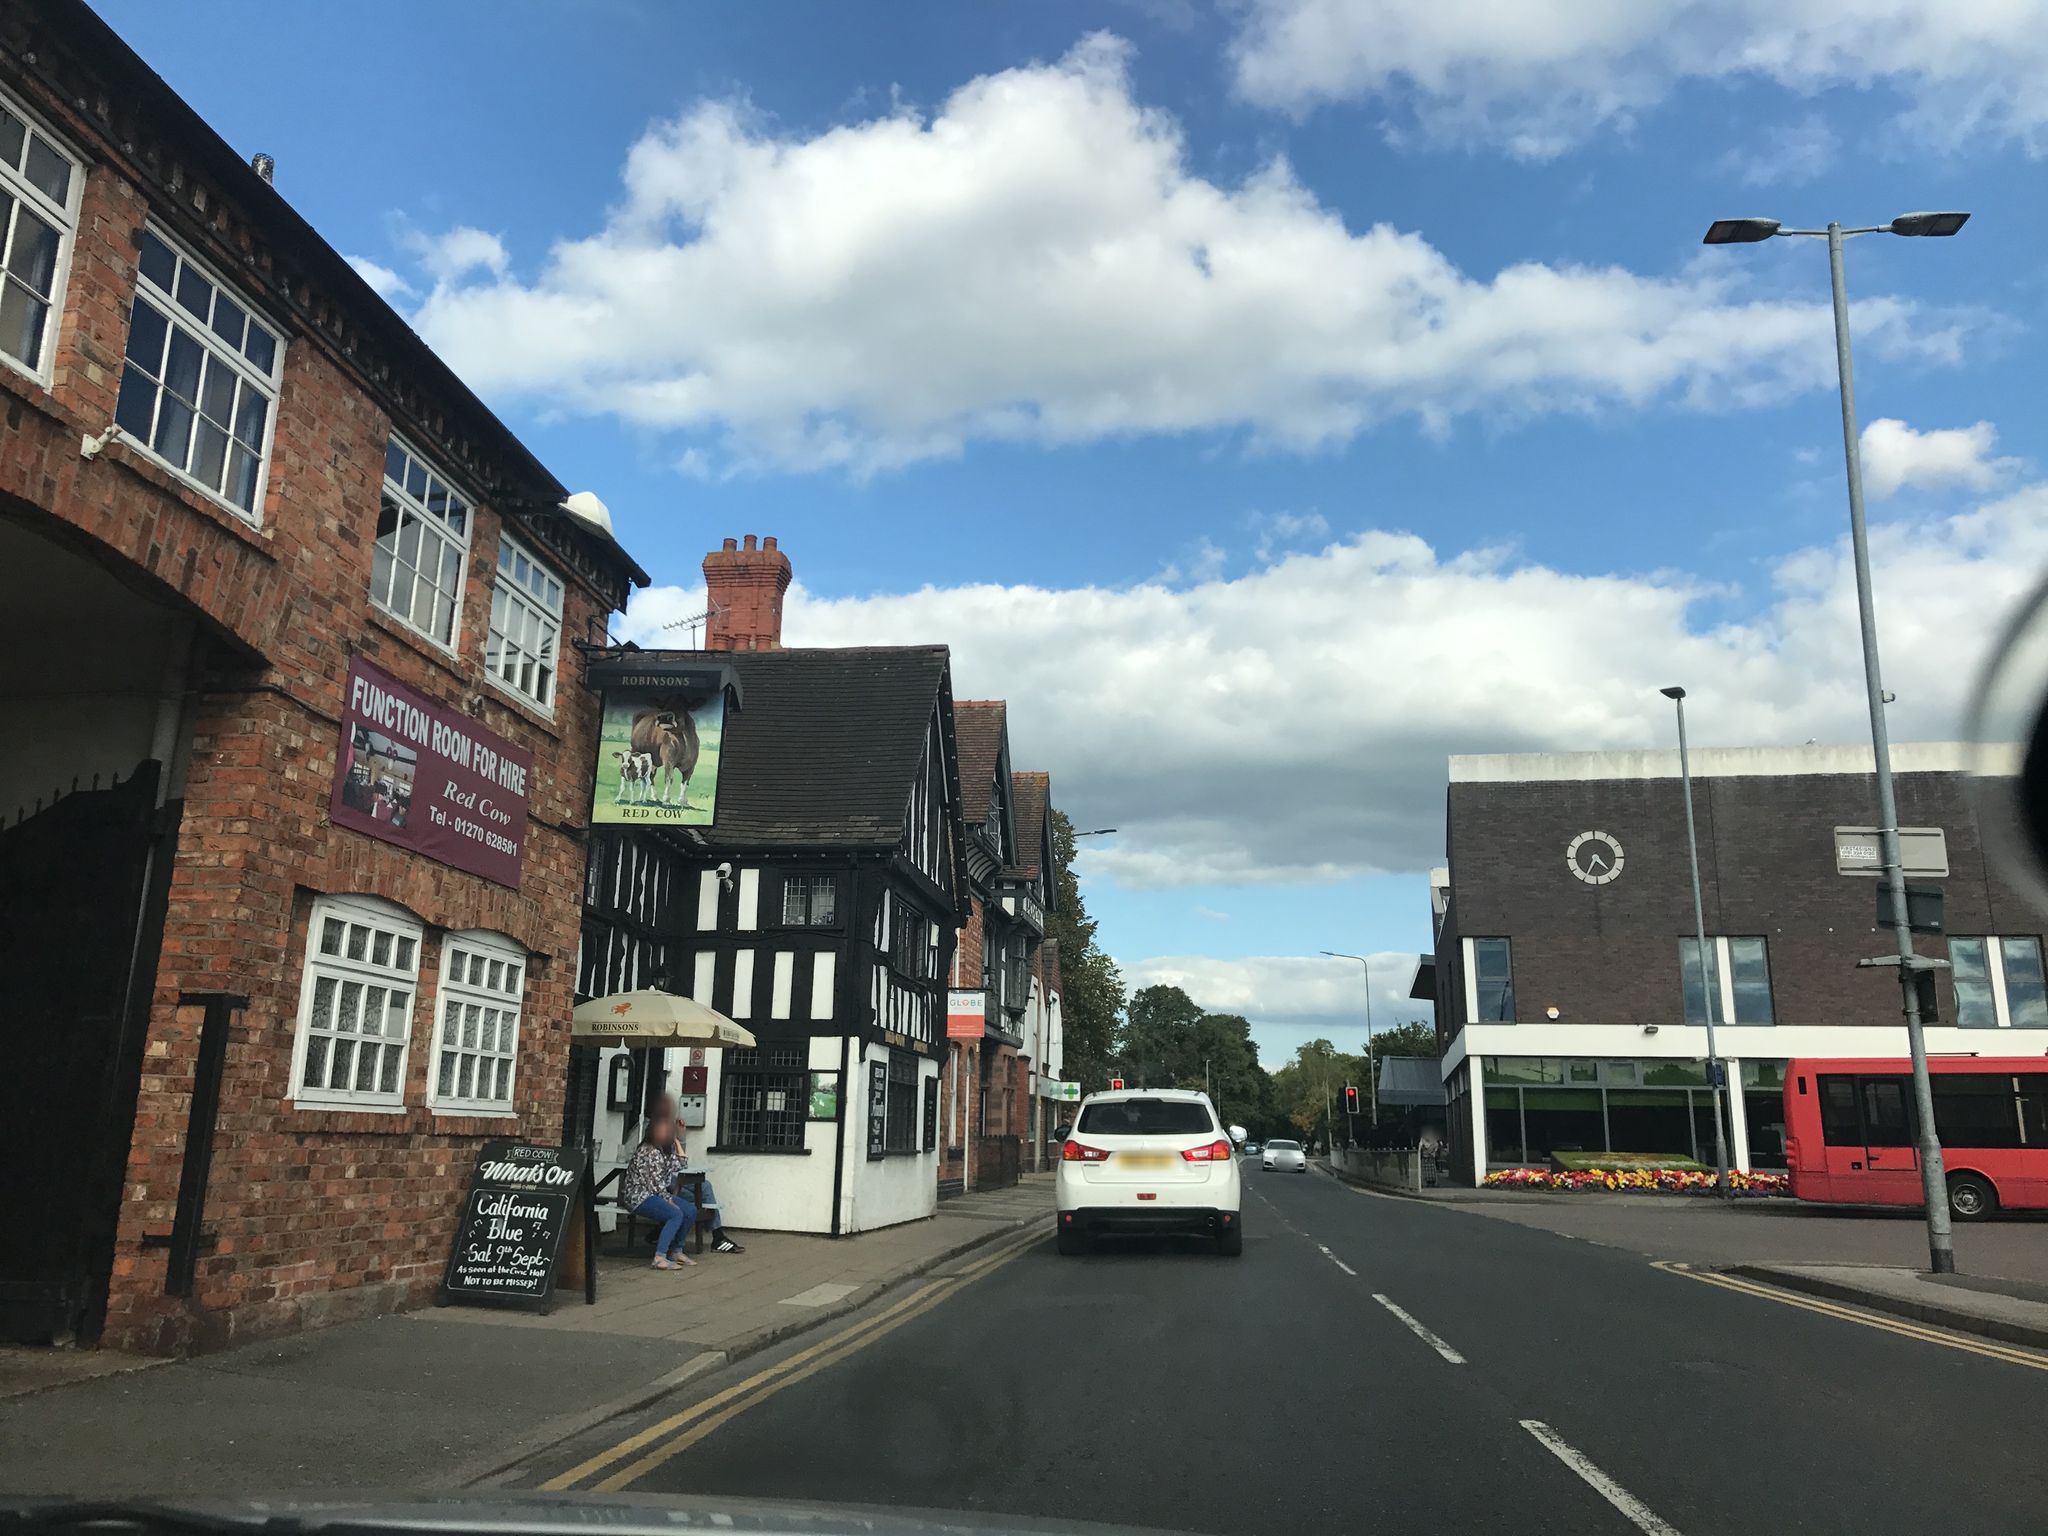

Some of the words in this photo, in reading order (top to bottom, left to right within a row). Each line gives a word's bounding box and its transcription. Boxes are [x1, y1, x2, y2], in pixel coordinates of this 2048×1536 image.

[622, 676, 690, 686] ROBINSONS
[352, 676, 430, 747] FUNCTION
[432, 720, 471, 768] ROOM
[473, 742, 497, 783] FOR
[499, 756, 526, 797] HIRE
[443, 780, 474, 810] Red
[479, 798, 511, 826] Cow
[622, 808, 649, 818] RED
[655, 809, 684, 819] COW
[430, 805, 446, 826] Tel
[454, 817, 484, 843] 01270
[486, 832, 518, 857] 628581
[591, 1023, 639, 1031] ROBINSONS
[514, 1149, 531, 1157] RED
[532, 1150, 551, 1159] COW
[545, 1165, 574, 1185] On
[477, 1194, 549, 1221] California
[486, 1218, 523, 1242] Blue
[468, 1243, 492, 1262] Sat
[496, 1245, 513, 1264] 9th
[457, 1265, 467, 1273] As
[487, 1265, 496, 1273] at
[498, 1266, 510, 1274] the
[529, 1269, 546, 1277] Hall
[463, 1276, 481, 1286] NOT
